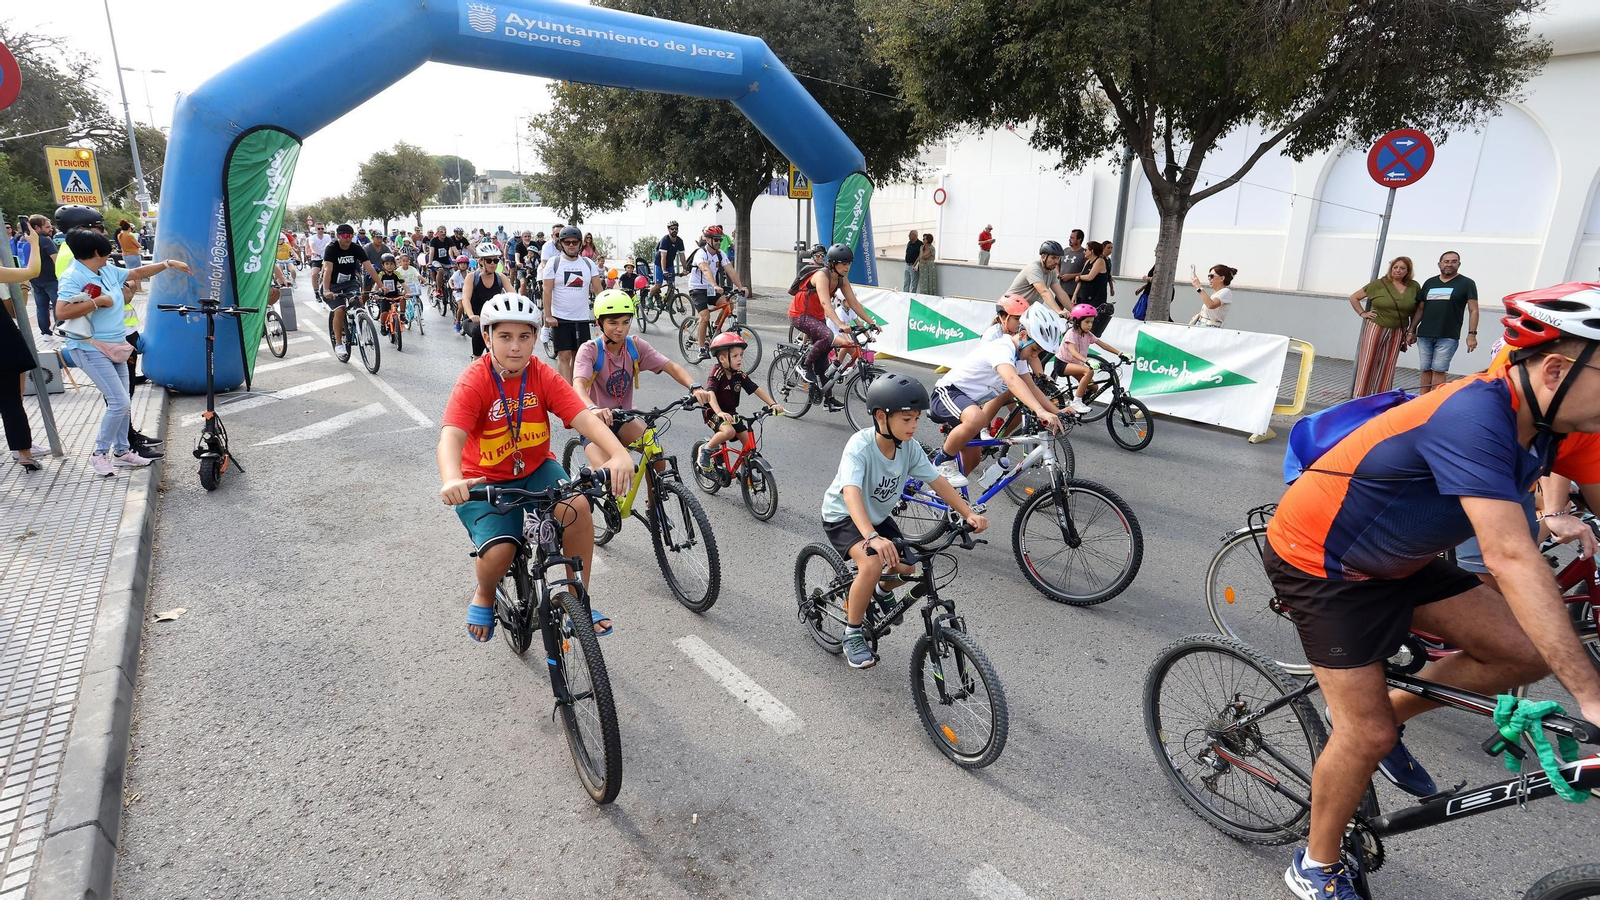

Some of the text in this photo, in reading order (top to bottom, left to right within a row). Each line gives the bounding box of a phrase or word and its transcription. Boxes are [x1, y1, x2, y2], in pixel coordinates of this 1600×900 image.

[504, 26, 581, 47] Deportes
[505, 12, 736, 60] Ayuntamiento de Jerez
[61, 194, 98, 204] PEATONES
[338, 255, 355, 264] VANS
[1529, 308, 1563, 327] YOUNG
[909, 318, 964, 340] El Corte Inglés
[1136, 357, 1149, 372] El
[1149, 360, 1179, 377] Corte
